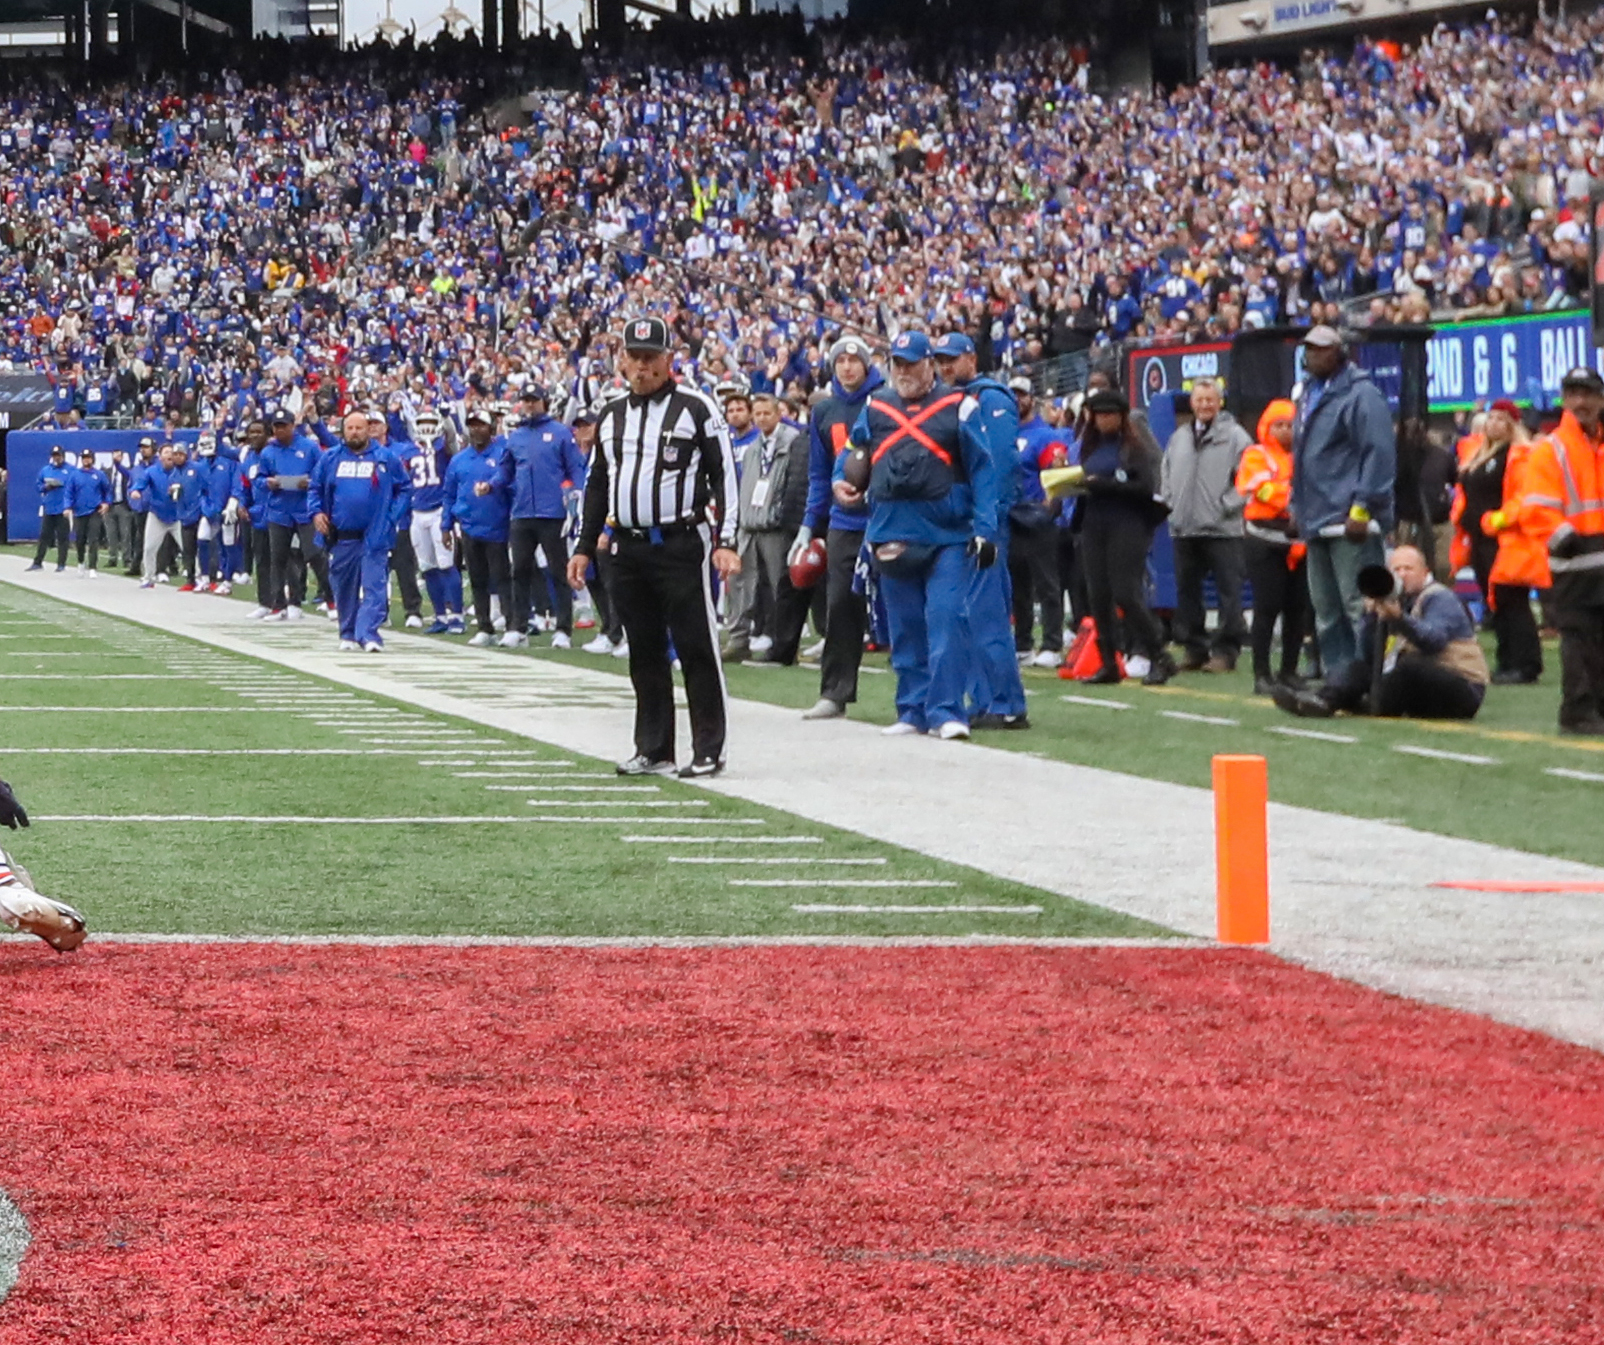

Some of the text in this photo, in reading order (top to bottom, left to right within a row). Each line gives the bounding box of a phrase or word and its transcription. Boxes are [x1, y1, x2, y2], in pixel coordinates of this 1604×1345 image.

[1425, 337, 1464, 398] 2ND
[1473, 335, 1490, 395] &
[1501, 332, 1518, 395] 6
[410, 454, 441, 489] 31
